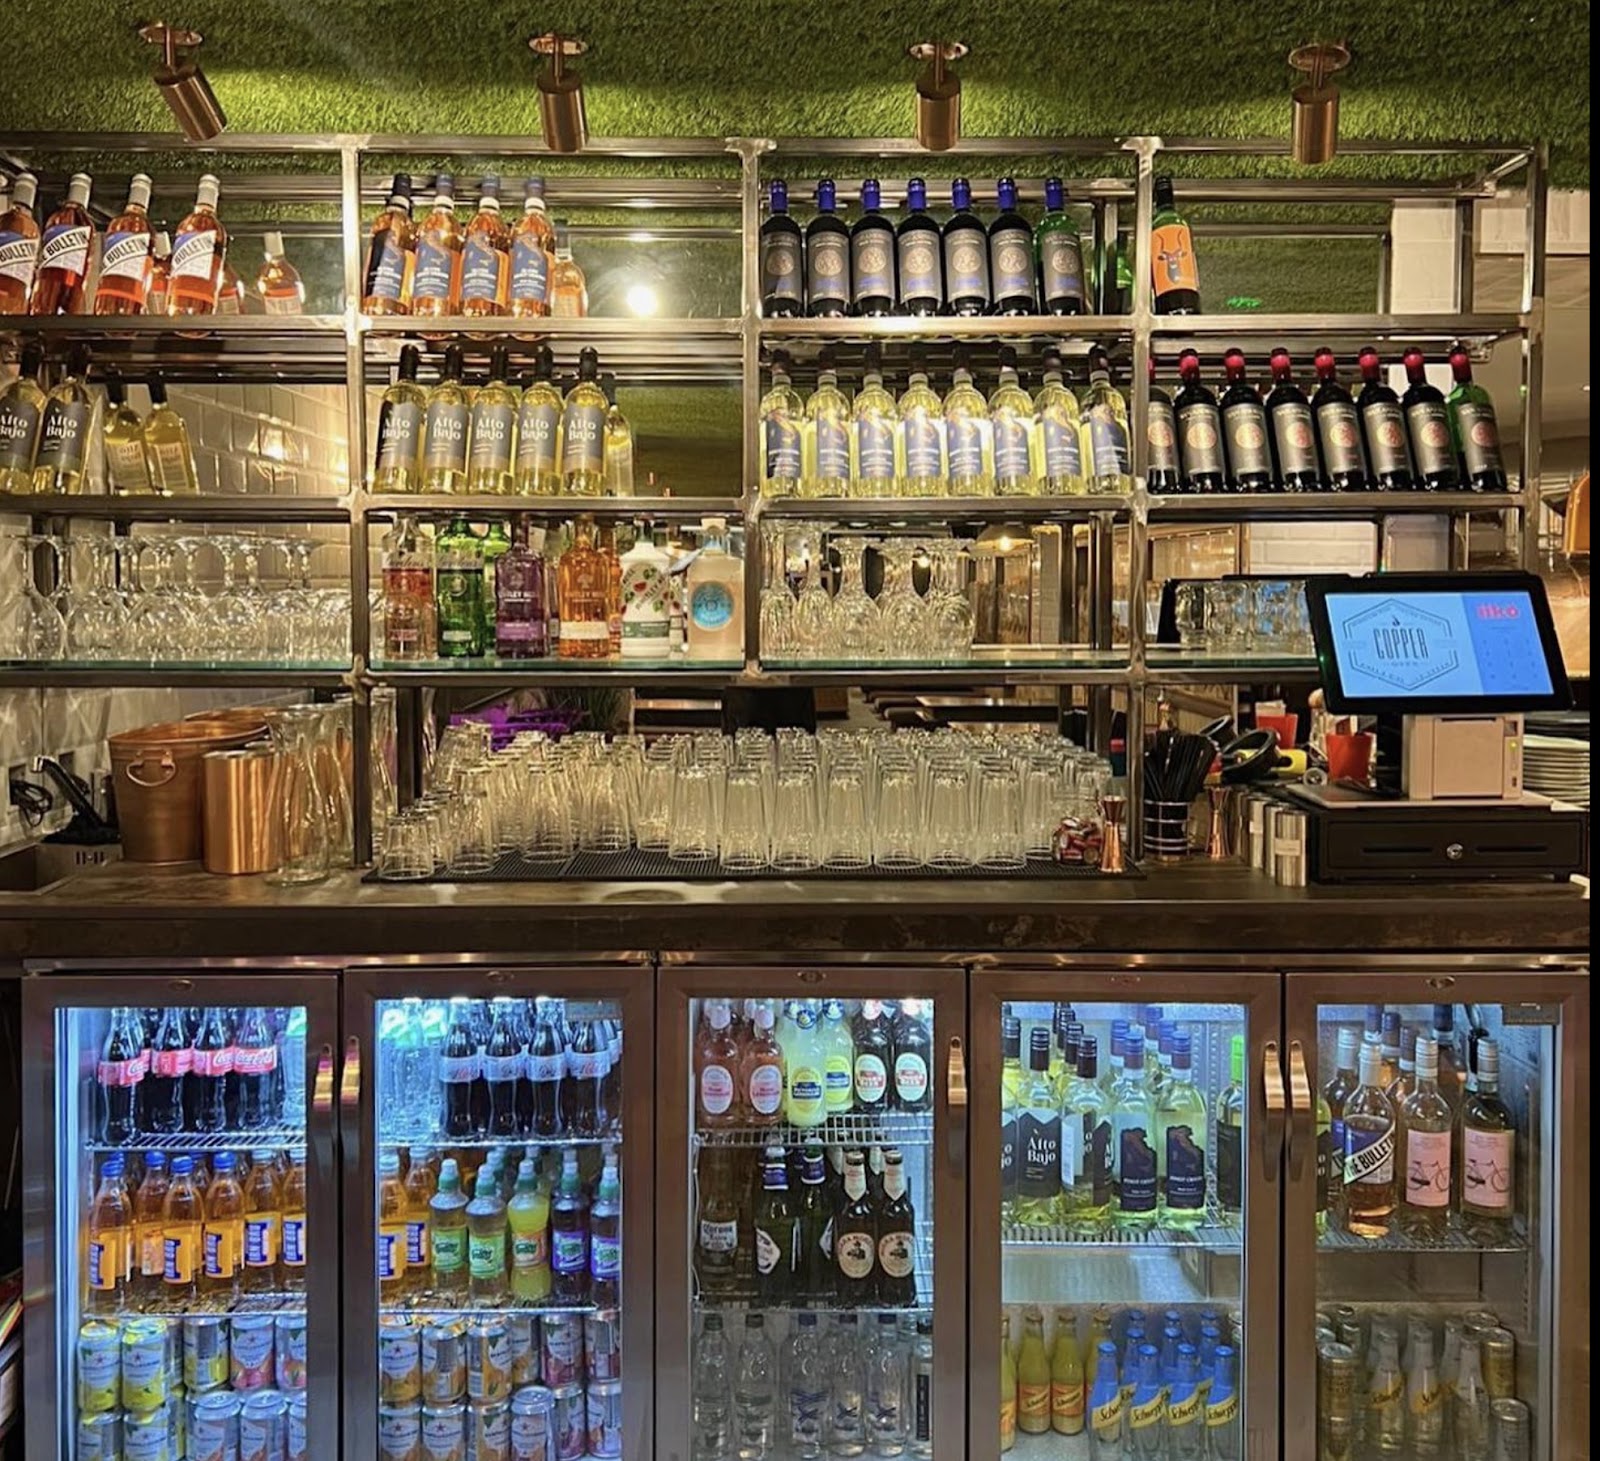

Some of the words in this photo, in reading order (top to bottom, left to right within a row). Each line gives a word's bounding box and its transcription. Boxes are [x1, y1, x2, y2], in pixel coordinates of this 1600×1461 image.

[46, 231, 87, 256] BULLETIN
[106, 237, 147, 264] BULLETIN
[1373, 627, 1429, 660] COPPER
[1027, 1149, 1056, 1166] Bajo
[1357, 1132, 1394, 1170] BULLET
